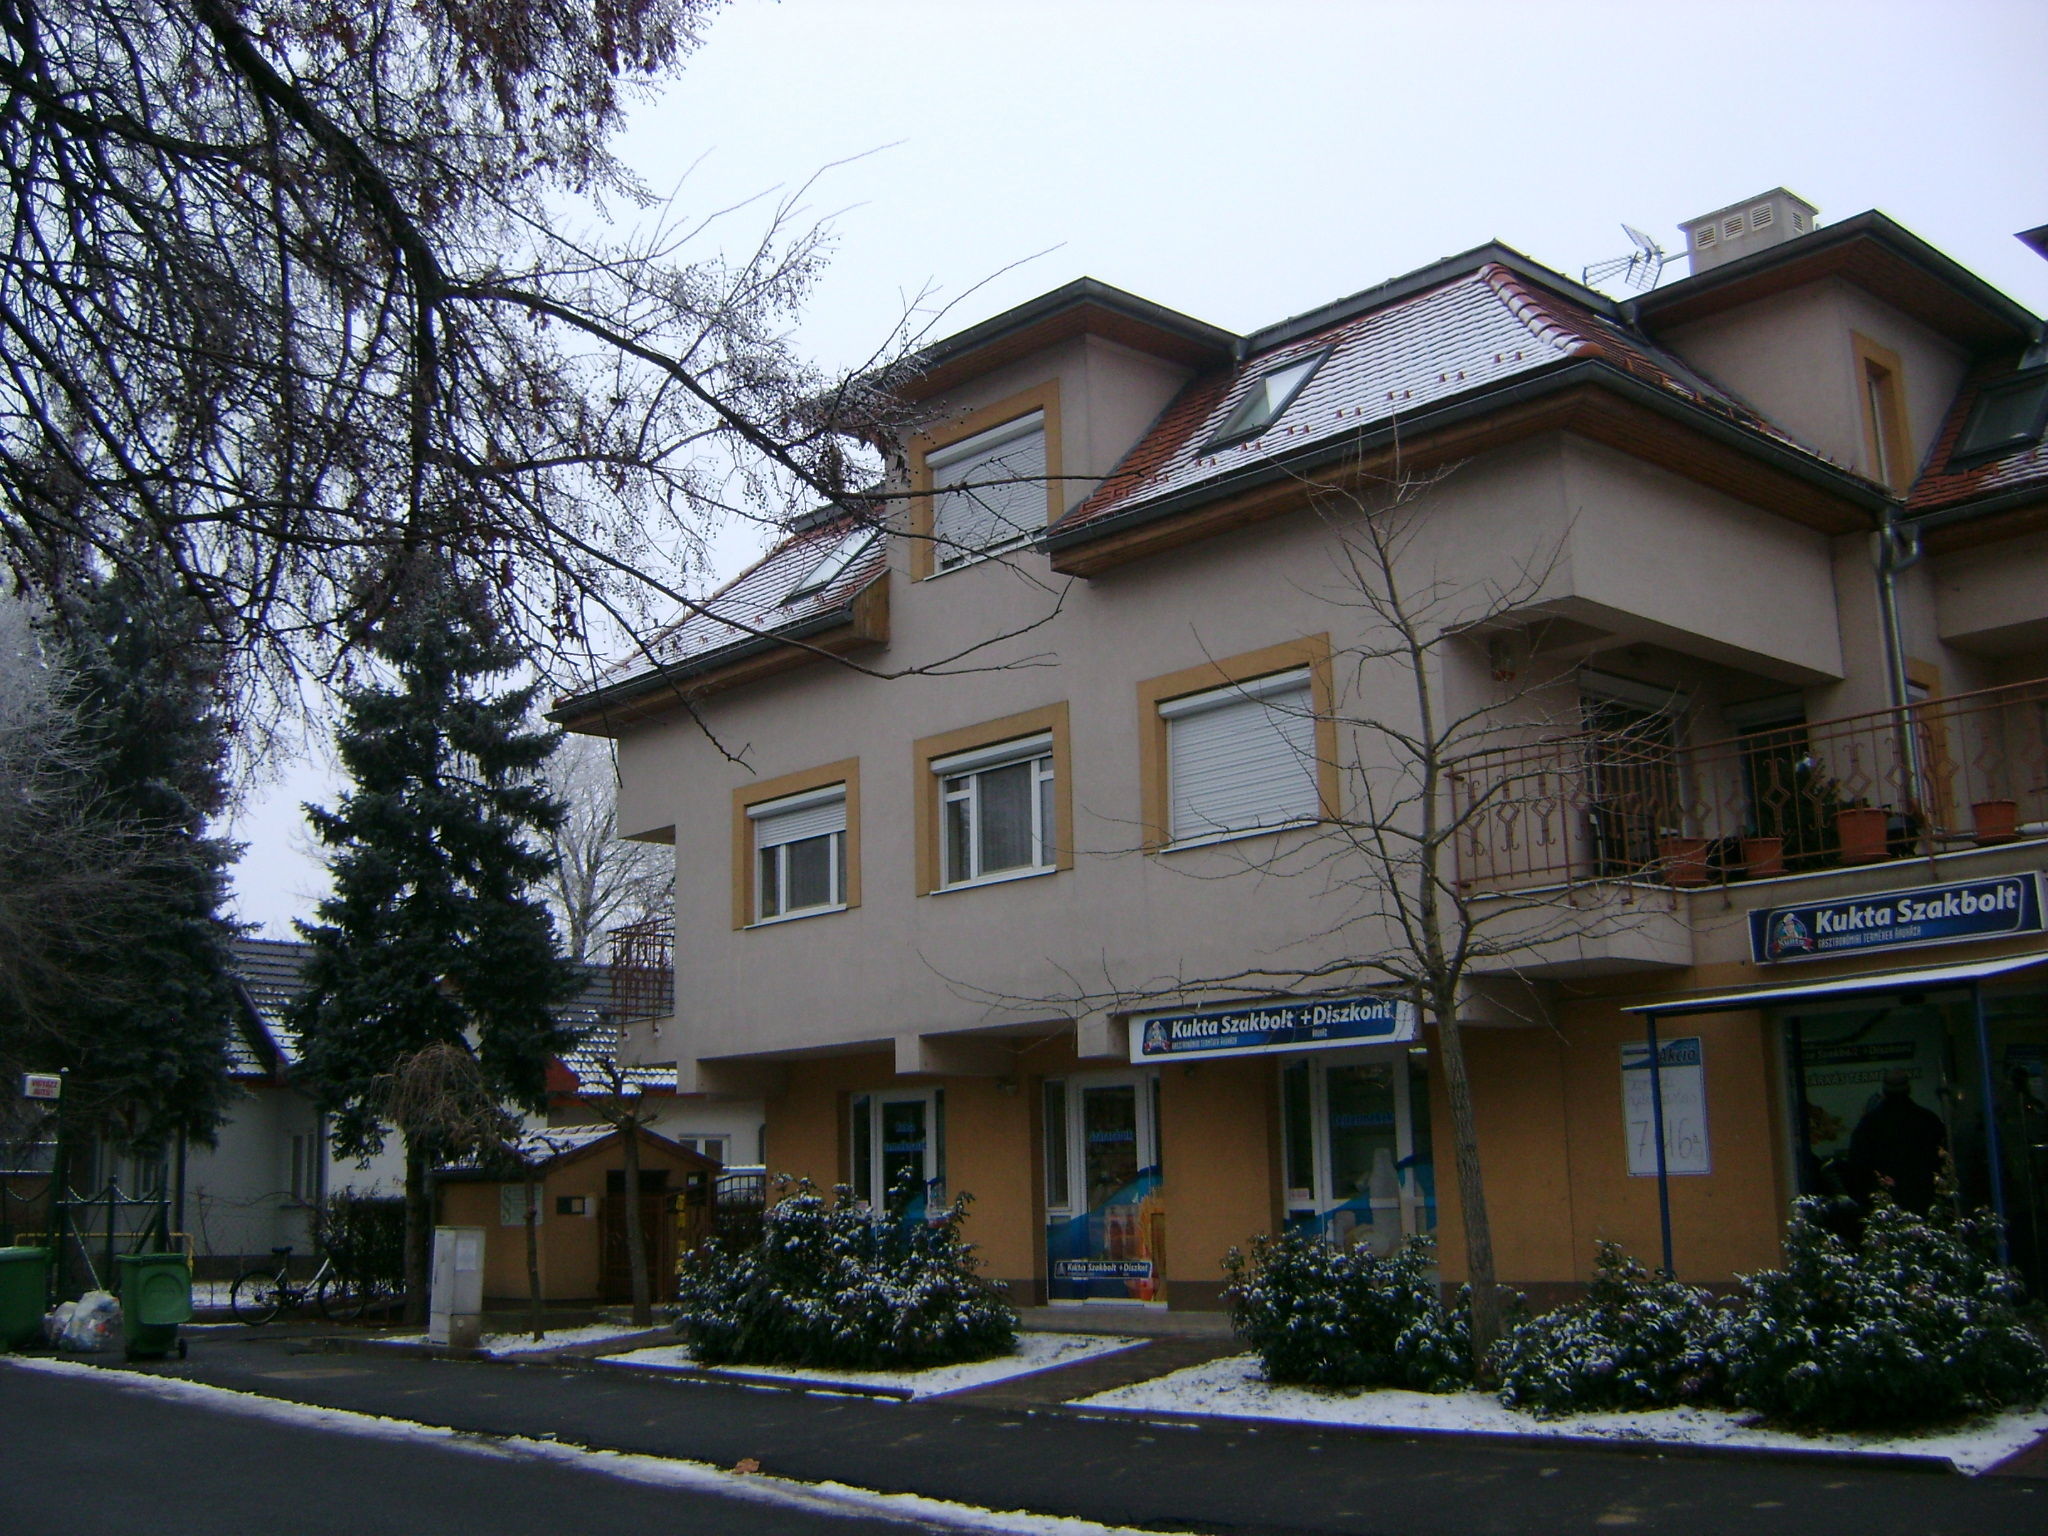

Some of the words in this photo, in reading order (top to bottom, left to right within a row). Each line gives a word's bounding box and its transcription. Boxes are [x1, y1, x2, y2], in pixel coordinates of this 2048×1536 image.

[1815, 906, 1891, 934] Kukta
[1897, 885, 2017, 923] Szakbolt
[1171, 1018, 1218, 1039] Kukta
[1220, 1009, 1294, 1034] Szakbolt
